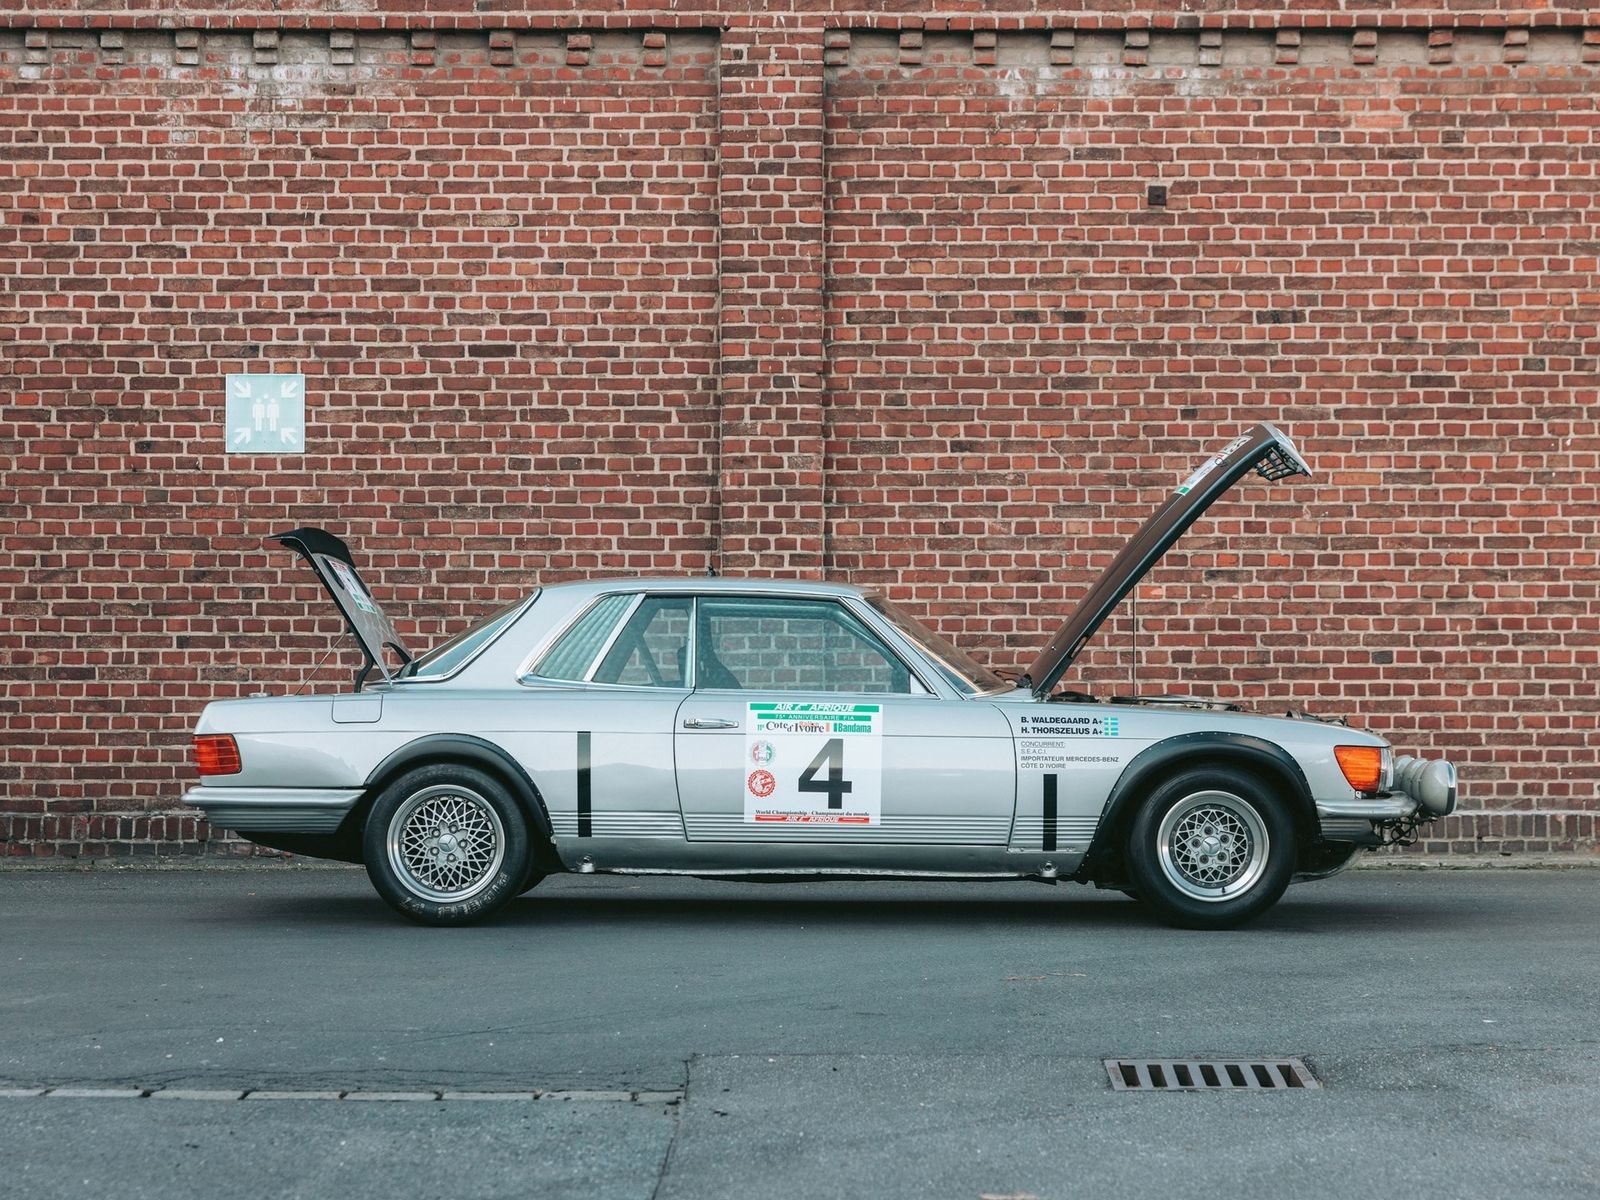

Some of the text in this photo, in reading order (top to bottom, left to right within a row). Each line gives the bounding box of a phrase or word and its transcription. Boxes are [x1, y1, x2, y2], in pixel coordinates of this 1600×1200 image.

[809, 704, 855, 712] AFRIQUE
[838, 723, 871, 733] Bandama
[1031, 727, 1090, 735] THORSZELIUS
[798, 738, 852, 809] 4
